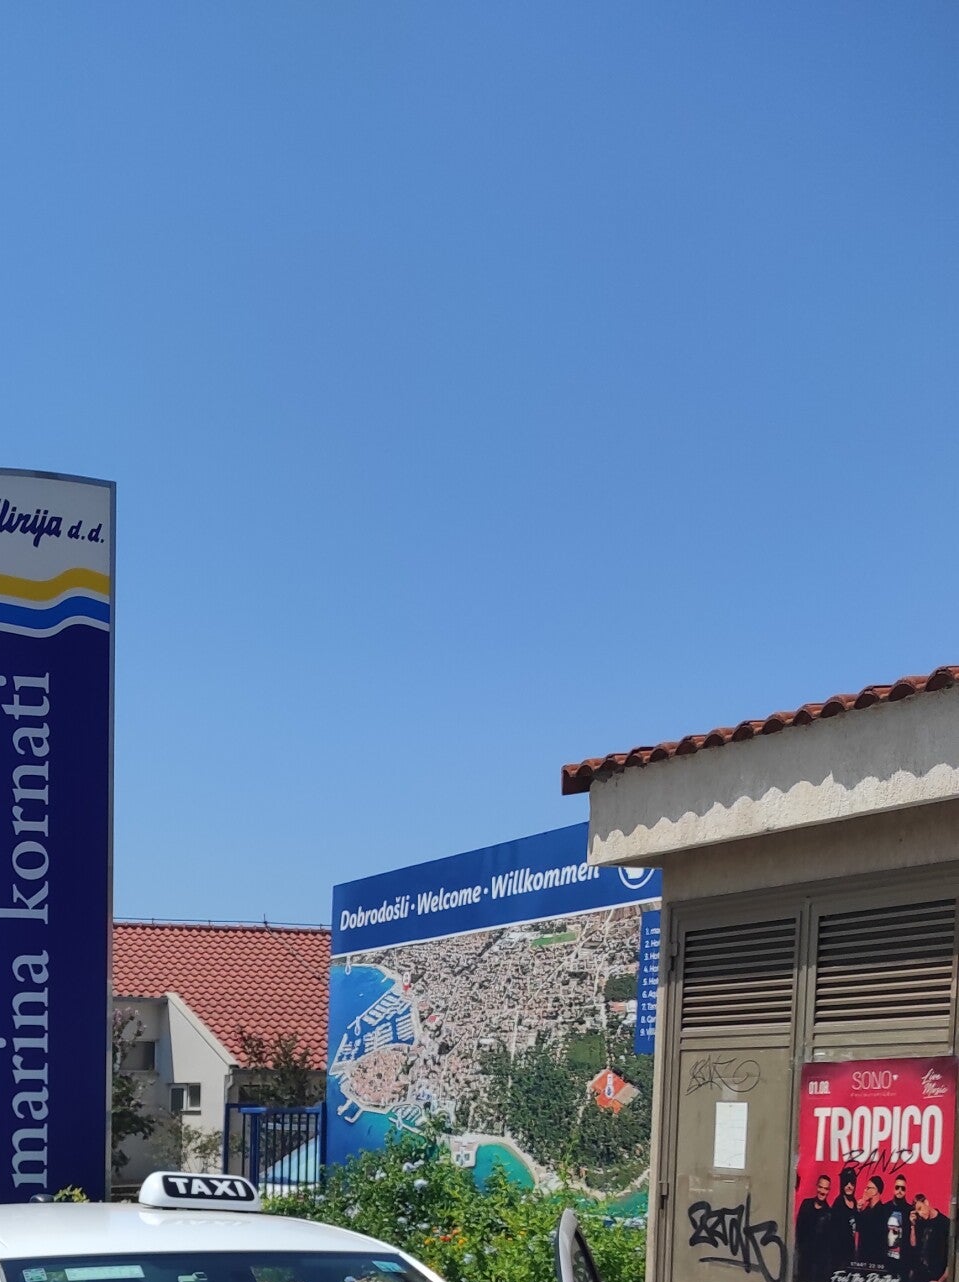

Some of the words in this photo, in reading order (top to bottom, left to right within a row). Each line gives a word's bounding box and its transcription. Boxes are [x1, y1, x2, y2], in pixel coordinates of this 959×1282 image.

[68, 520, 105, 543] d.d.
[340, 894, 410, 931] Dobrodošli
[417, 889, 481, 915] Welcome
[491, 862, 600, 899] Willkommen
[814, 1104, 943, 1165] TROPICO
[167, 1177, 247, 1197] TAXI
